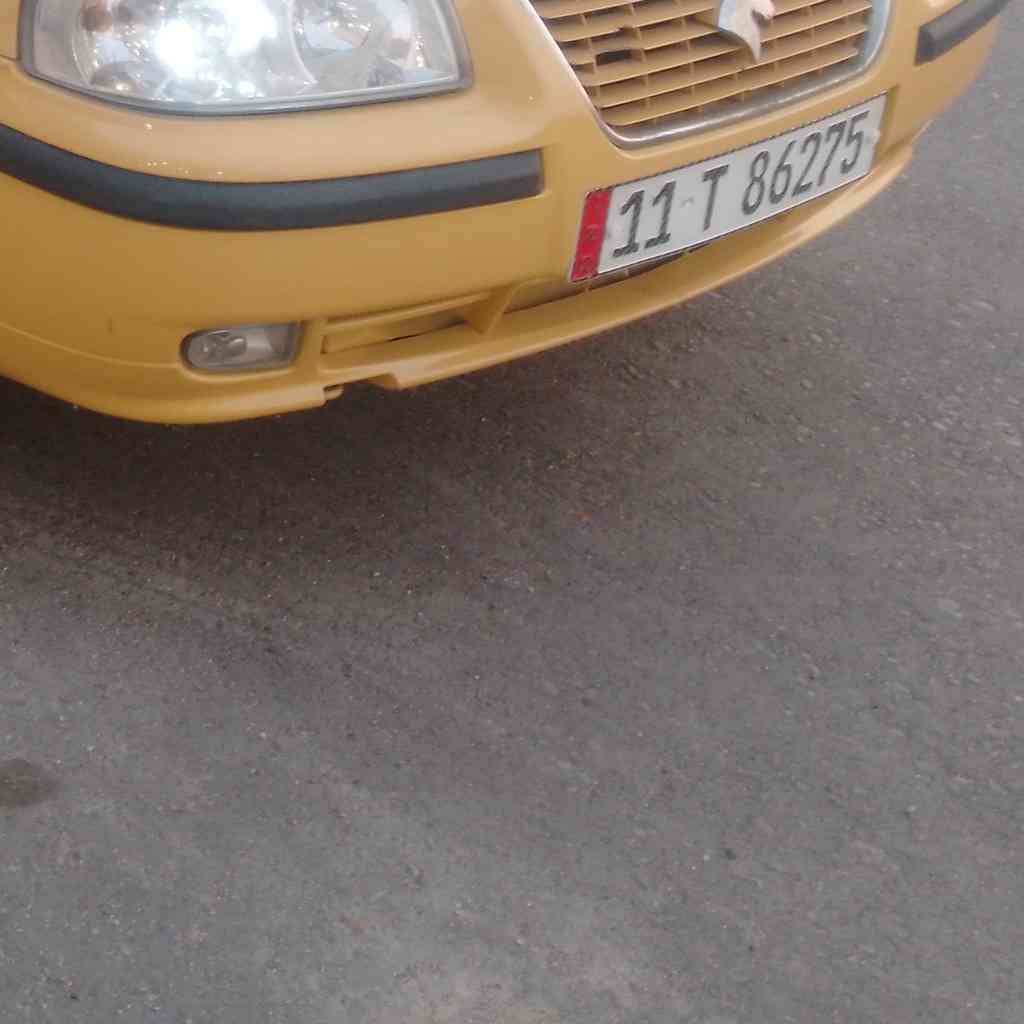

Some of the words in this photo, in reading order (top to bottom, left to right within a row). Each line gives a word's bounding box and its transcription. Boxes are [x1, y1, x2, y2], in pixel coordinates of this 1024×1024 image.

[613, 180, 676, 258] 11
[702, 164, 728, 232] T
[741, 110, 870, 216] 86275
